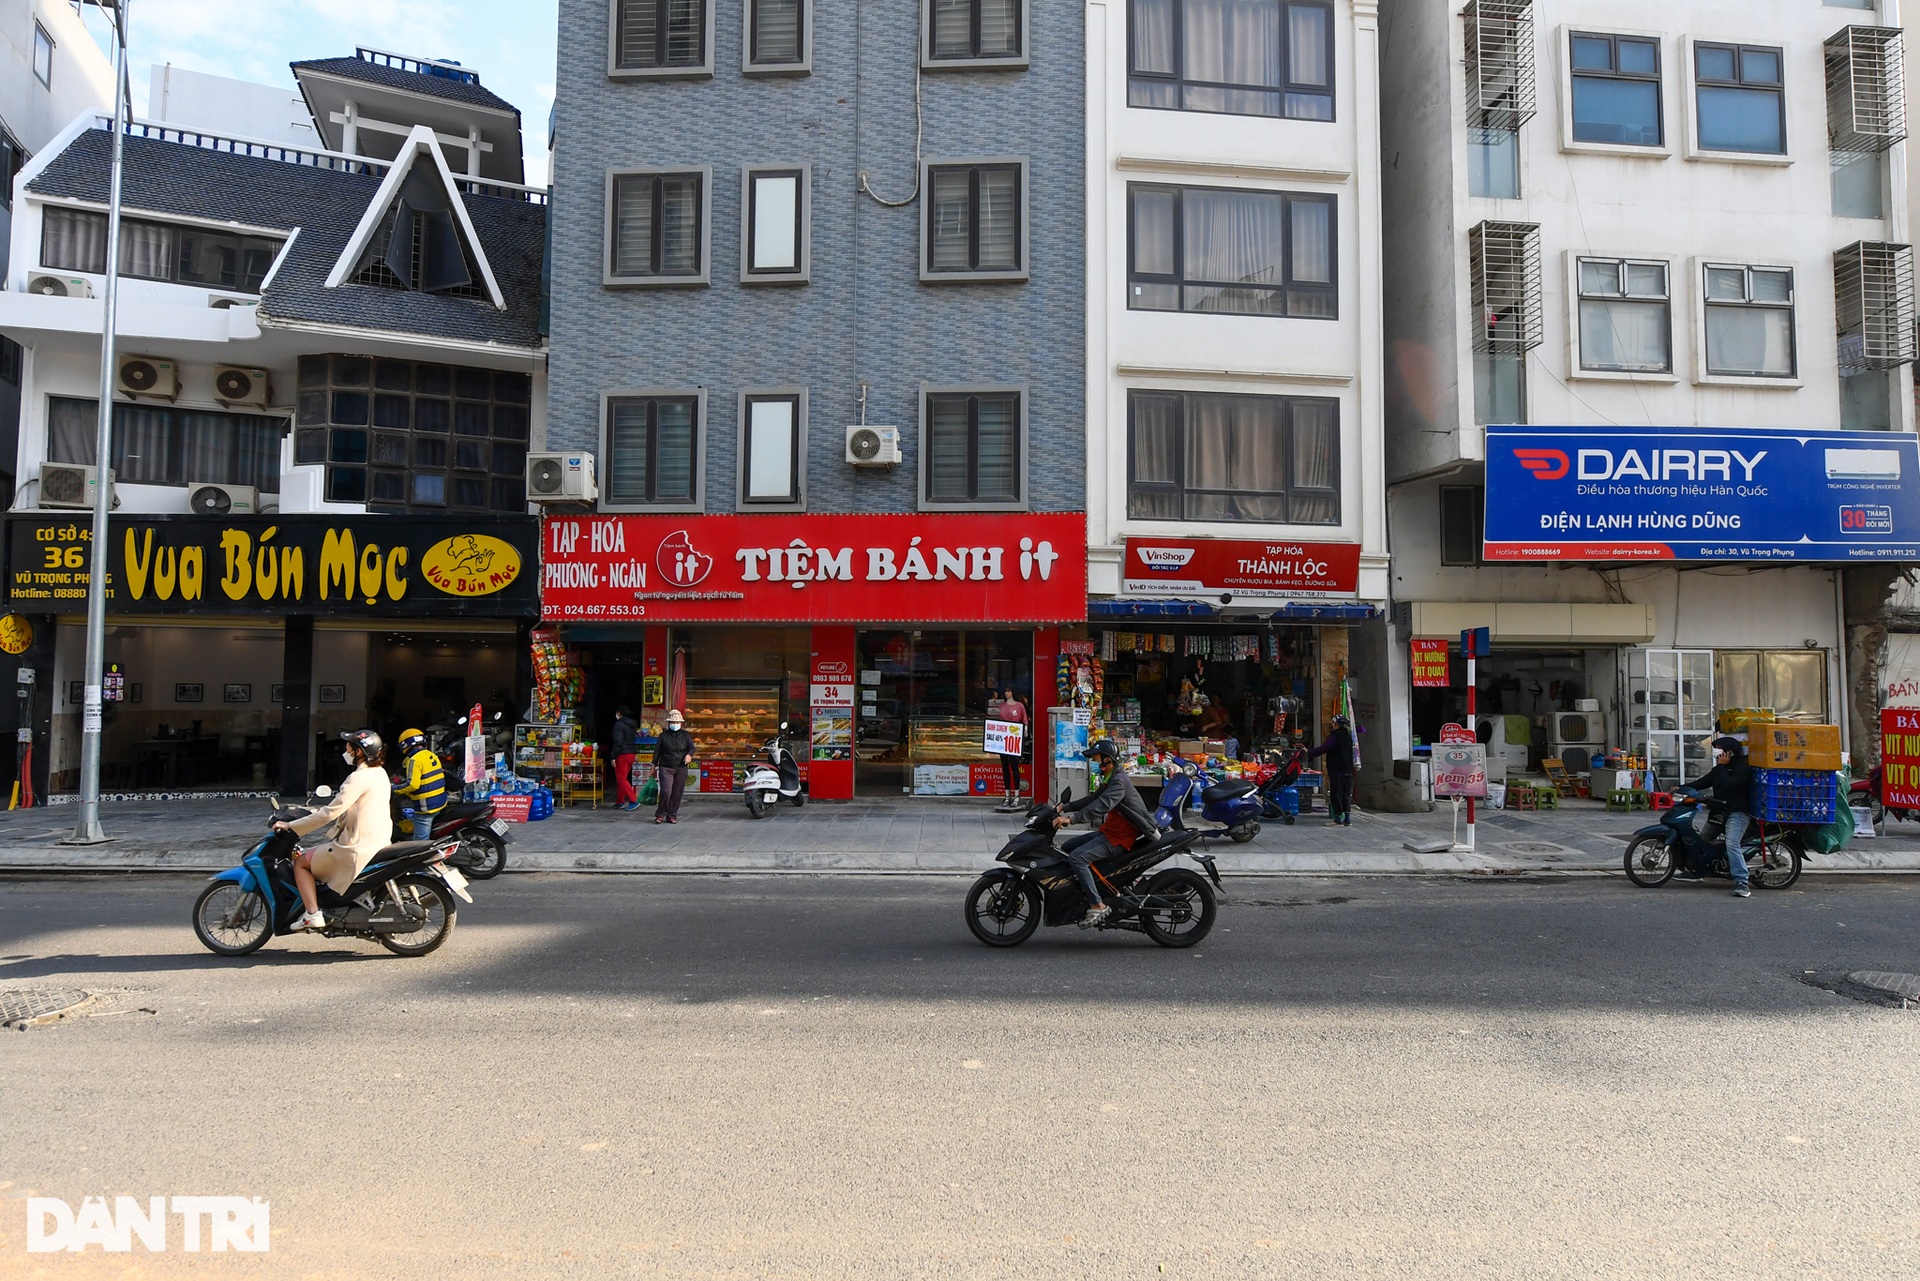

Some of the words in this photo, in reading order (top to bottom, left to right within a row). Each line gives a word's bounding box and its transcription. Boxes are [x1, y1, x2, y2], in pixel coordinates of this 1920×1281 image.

[1577, 448, 1768, 481] DAIRRY
[1577, 484, 1604, 496] Điều
[1608, 484, 1631, 496] hòa
[1634, 484, 1678, 497] thương
[1681, 484, 1708, 498] hiệu
[1710, 484, 1734, 496] Hàn
[1736, 484, 1768, 498] Quốc
[1540, 511, 1582, 532] ĐIỆN
[1586, 514, 1632, 532] LẠNH
[1638, 512, 1687, 529] HÙNG
[1692, 512, 1741, 529] DŨNG
[1842, 510, 1866, 528] 30
[36, 526, 55, 541] CƠ
[58, 524, 77, 541] SỞ
[551, 522, 580, 558] TẠP
[591, 516, 626, 552] HÓA
[44, 546, 84, 568] 36
[1266, 546, 1284, 556] TẠP
[1285, 545, 1304, 556] HÓA
[1701, 548, 1712, 556] Địa
[1728, 548, 1739, 556] 30,
[1751, 549, 1771, 557] Trọng
[1772, 549, 1794, 557] Phụng
[124, 528, 204, 600] Vua
[220, 526, 304, 600] Bún
[320, 528, 408, 605] Mọc
[674, 552, 700, 582] it
[736, 538, 854, 589] TIỆM
[866, 536, 1004, 581] BÁNH
[1019, 536, 1059, 581] it
[1238, 557, 1290, 574] THÀNH
[1294, 558, 1328, 579] LỘC
[15, 570, 31, 584] VŨ
[34, 572, 71, 586] TRỌNG
[74, 573, 112, 584] PHG
[427, 565, 451, 588] Vua
[456, 578, 486, 593] Bún
[489, 564, 516, 588] Mọc
[545, 562, 598, 588] PHƯƠNG
[609, 558, 647, 588] NGÂN
[10, 588, 51, 598] Hotline:
[53, 588, 87, 598] 08880
[544, 606, 561, 615] ĐT:
[565, 606, 645, 615] 024.667.553.03
[1421, 641, 1438, 649] BÁN
[1424, 650, 1446, 663] NƯỚNG
[1427, 666, 1446, 678] QUAY
[825, 686, 838, 698] 34
[986, 733, 995, 741] SALE
[1004, 735, 1021, 754] 10K
[1885, 734, 1902, 760] VỊT
[1436, 773, 1465, 786] Kem
[1467, 771, 1484, 784] 35
[1886, 763, 1905, 789] VỊT
